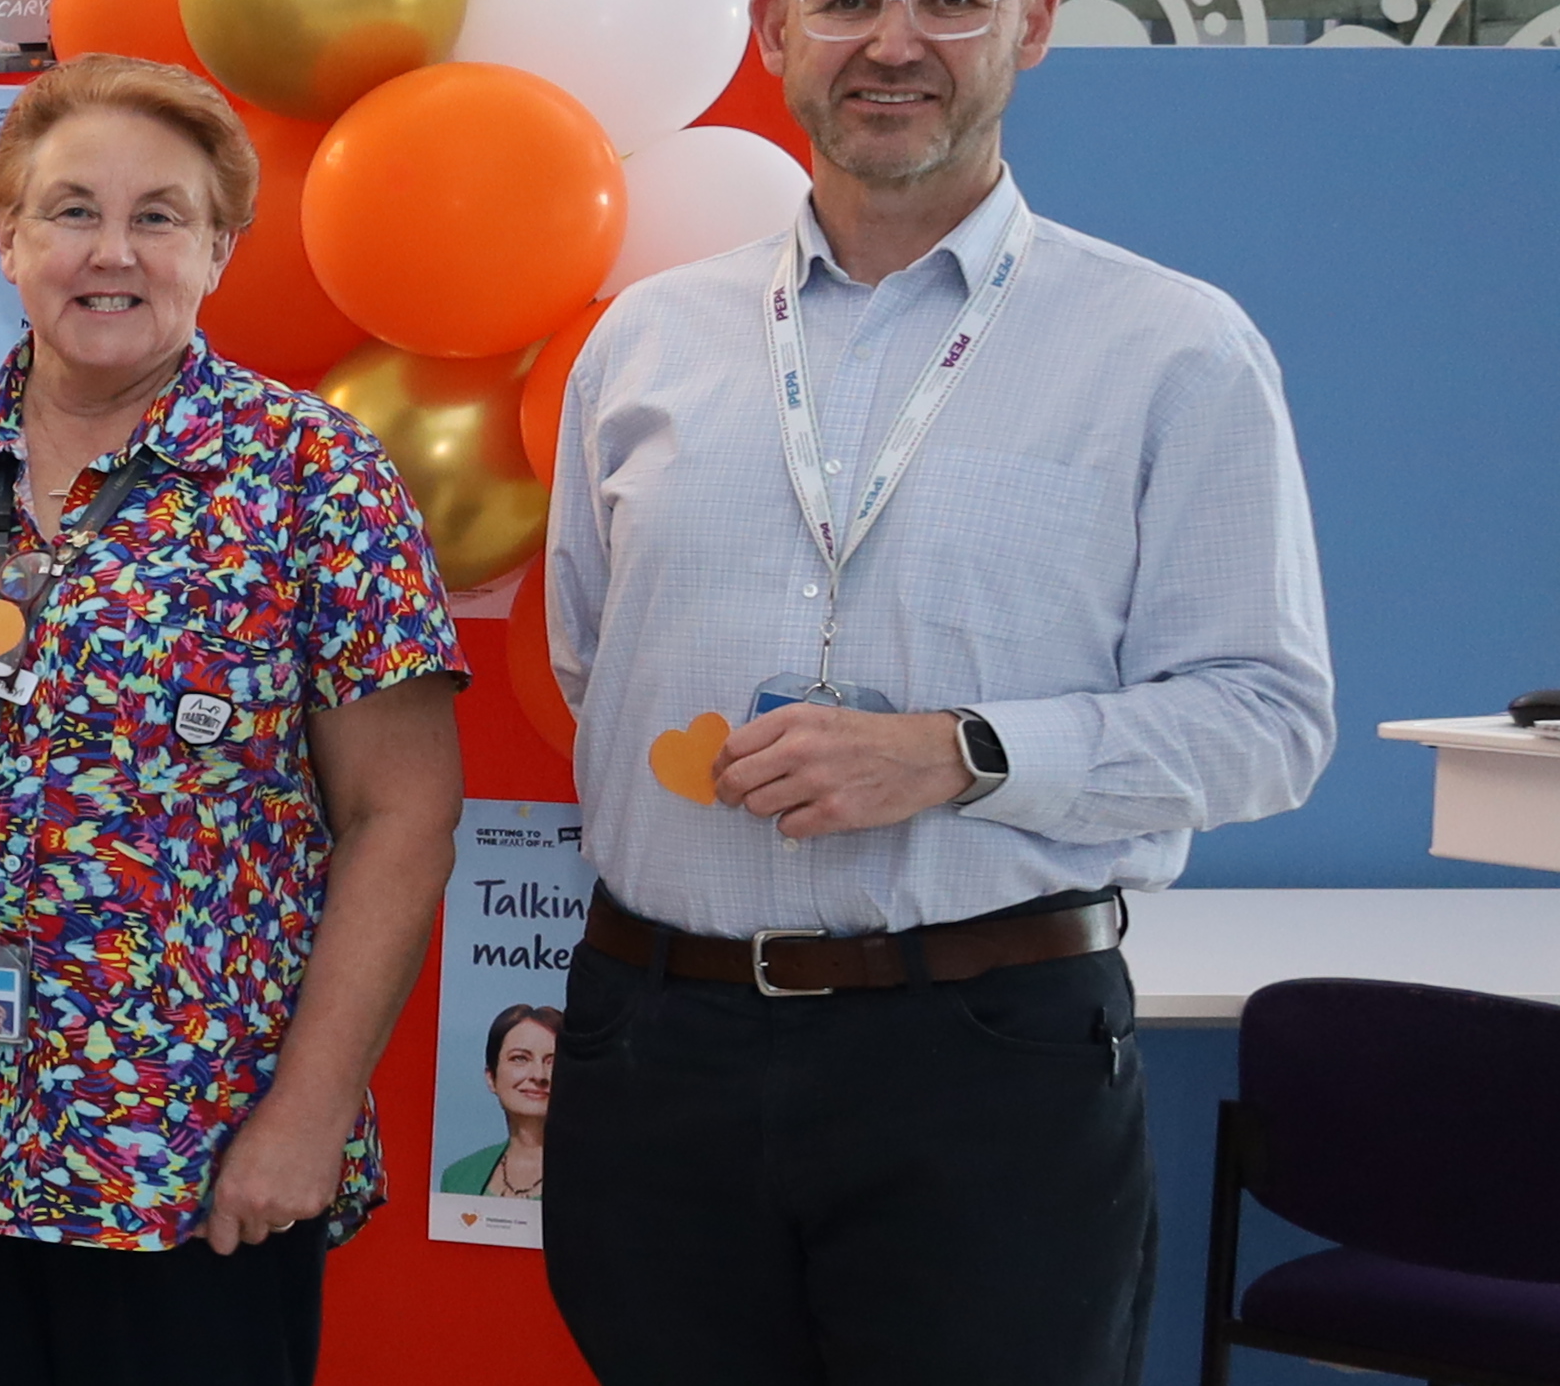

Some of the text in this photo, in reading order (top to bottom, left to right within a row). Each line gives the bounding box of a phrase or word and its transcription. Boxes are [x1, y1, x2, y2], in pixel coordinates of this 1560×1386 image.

[940, 332, 972, 368] PEPA
[476, 827, 541, 839] GETTING TO
[476, 836, 497, 847] THE
[525, 837, 540, 848] OF
[473, 878, 584, 921] Talkin
[473, 933, 572, 970] make
